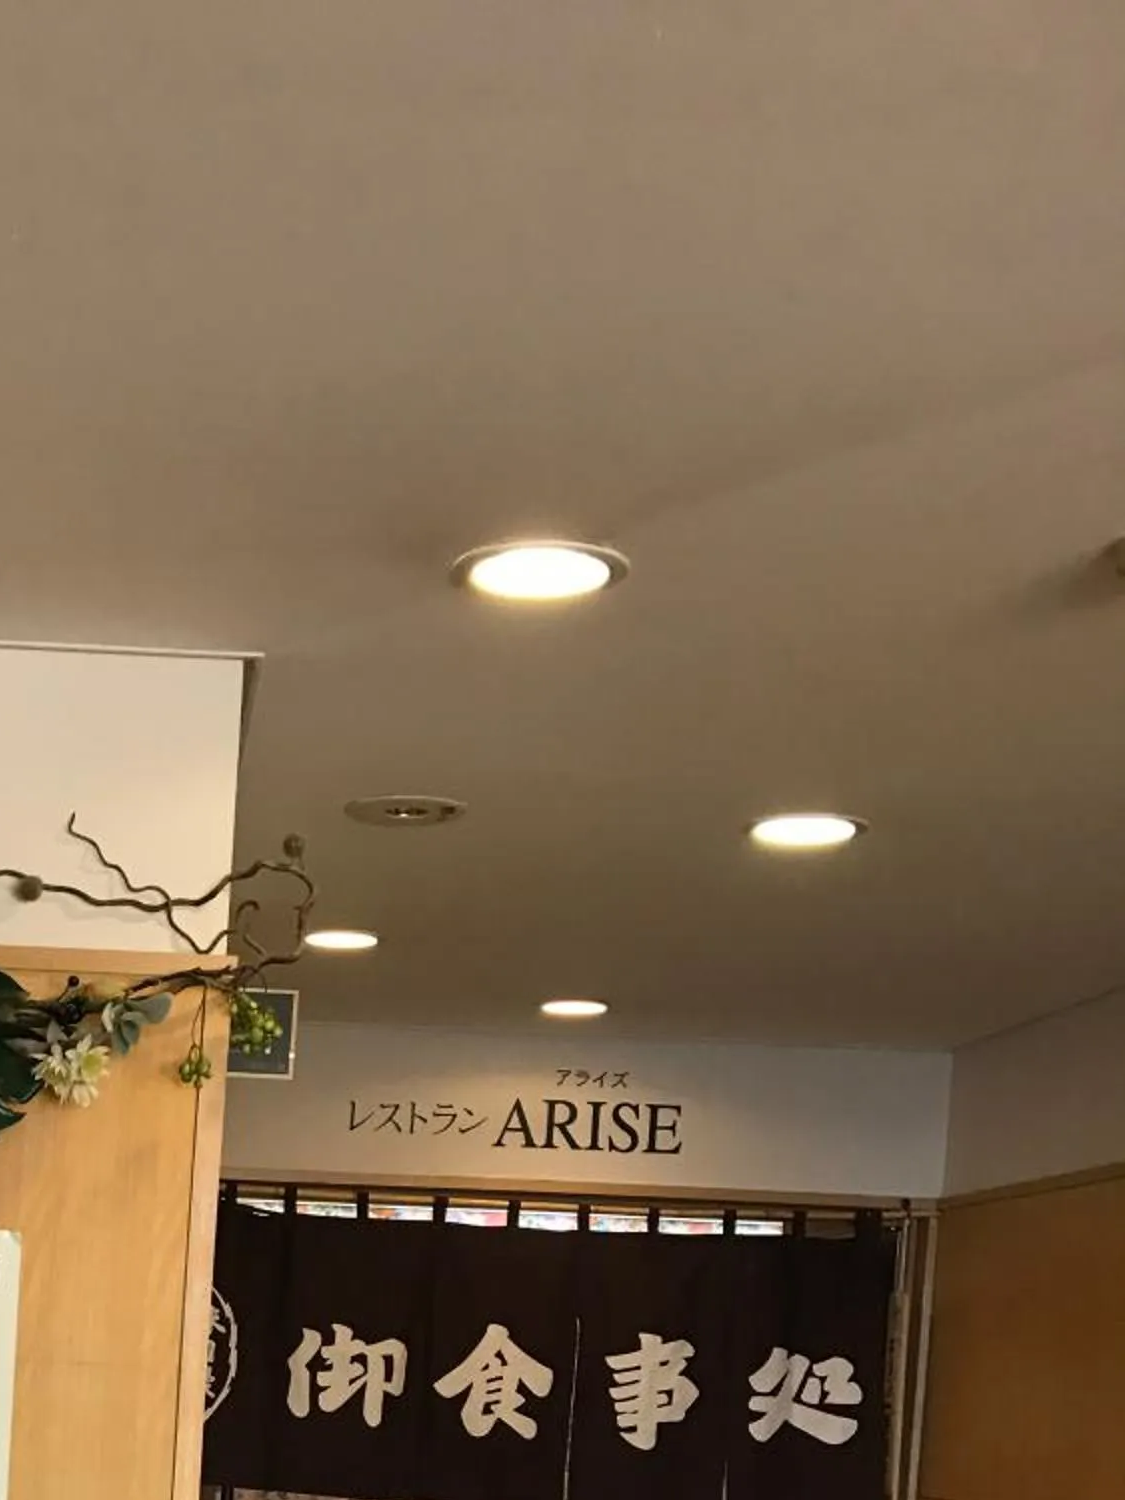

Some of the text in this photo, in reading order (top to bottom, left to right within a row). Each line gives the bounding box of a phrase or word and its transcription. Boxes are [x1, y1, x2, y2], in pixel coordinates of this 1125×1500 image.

[556, 1069, 630, 1088] アライズ
[348, 1098, 683, 1155] レストラン ARISE
[286, 1322, 864, 1452] 御食事処
